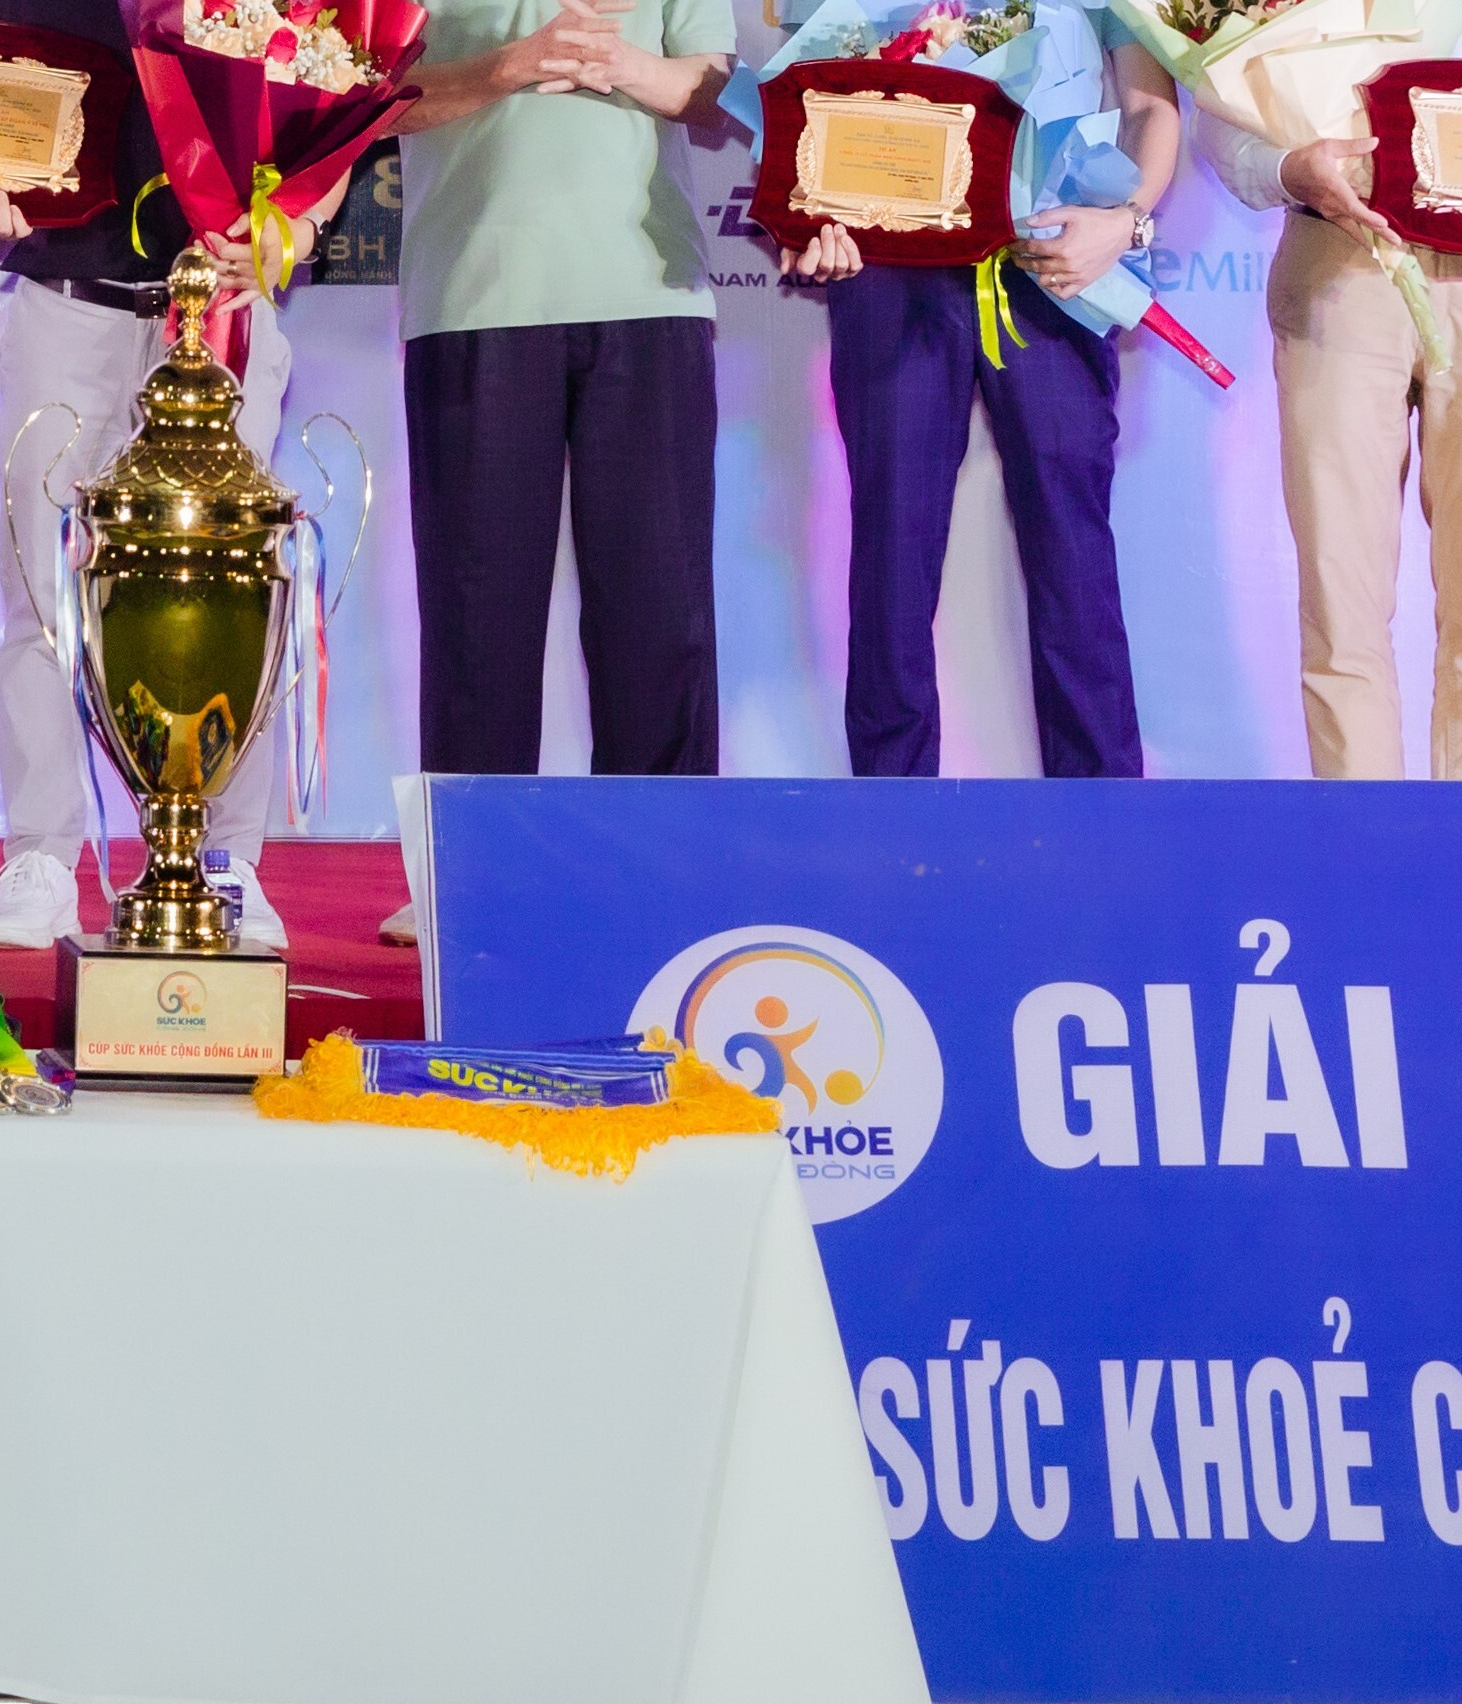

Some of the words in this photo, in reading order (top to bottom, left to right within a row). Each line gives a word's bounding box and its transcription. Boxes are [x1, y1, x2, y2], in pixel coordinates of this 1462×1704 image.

[1012, 918, 1408, 1169] GIẢI
[857, 1319, 1071, 1543] SỨC
[1100, 1296, 1385, 1543] KHOẺ
